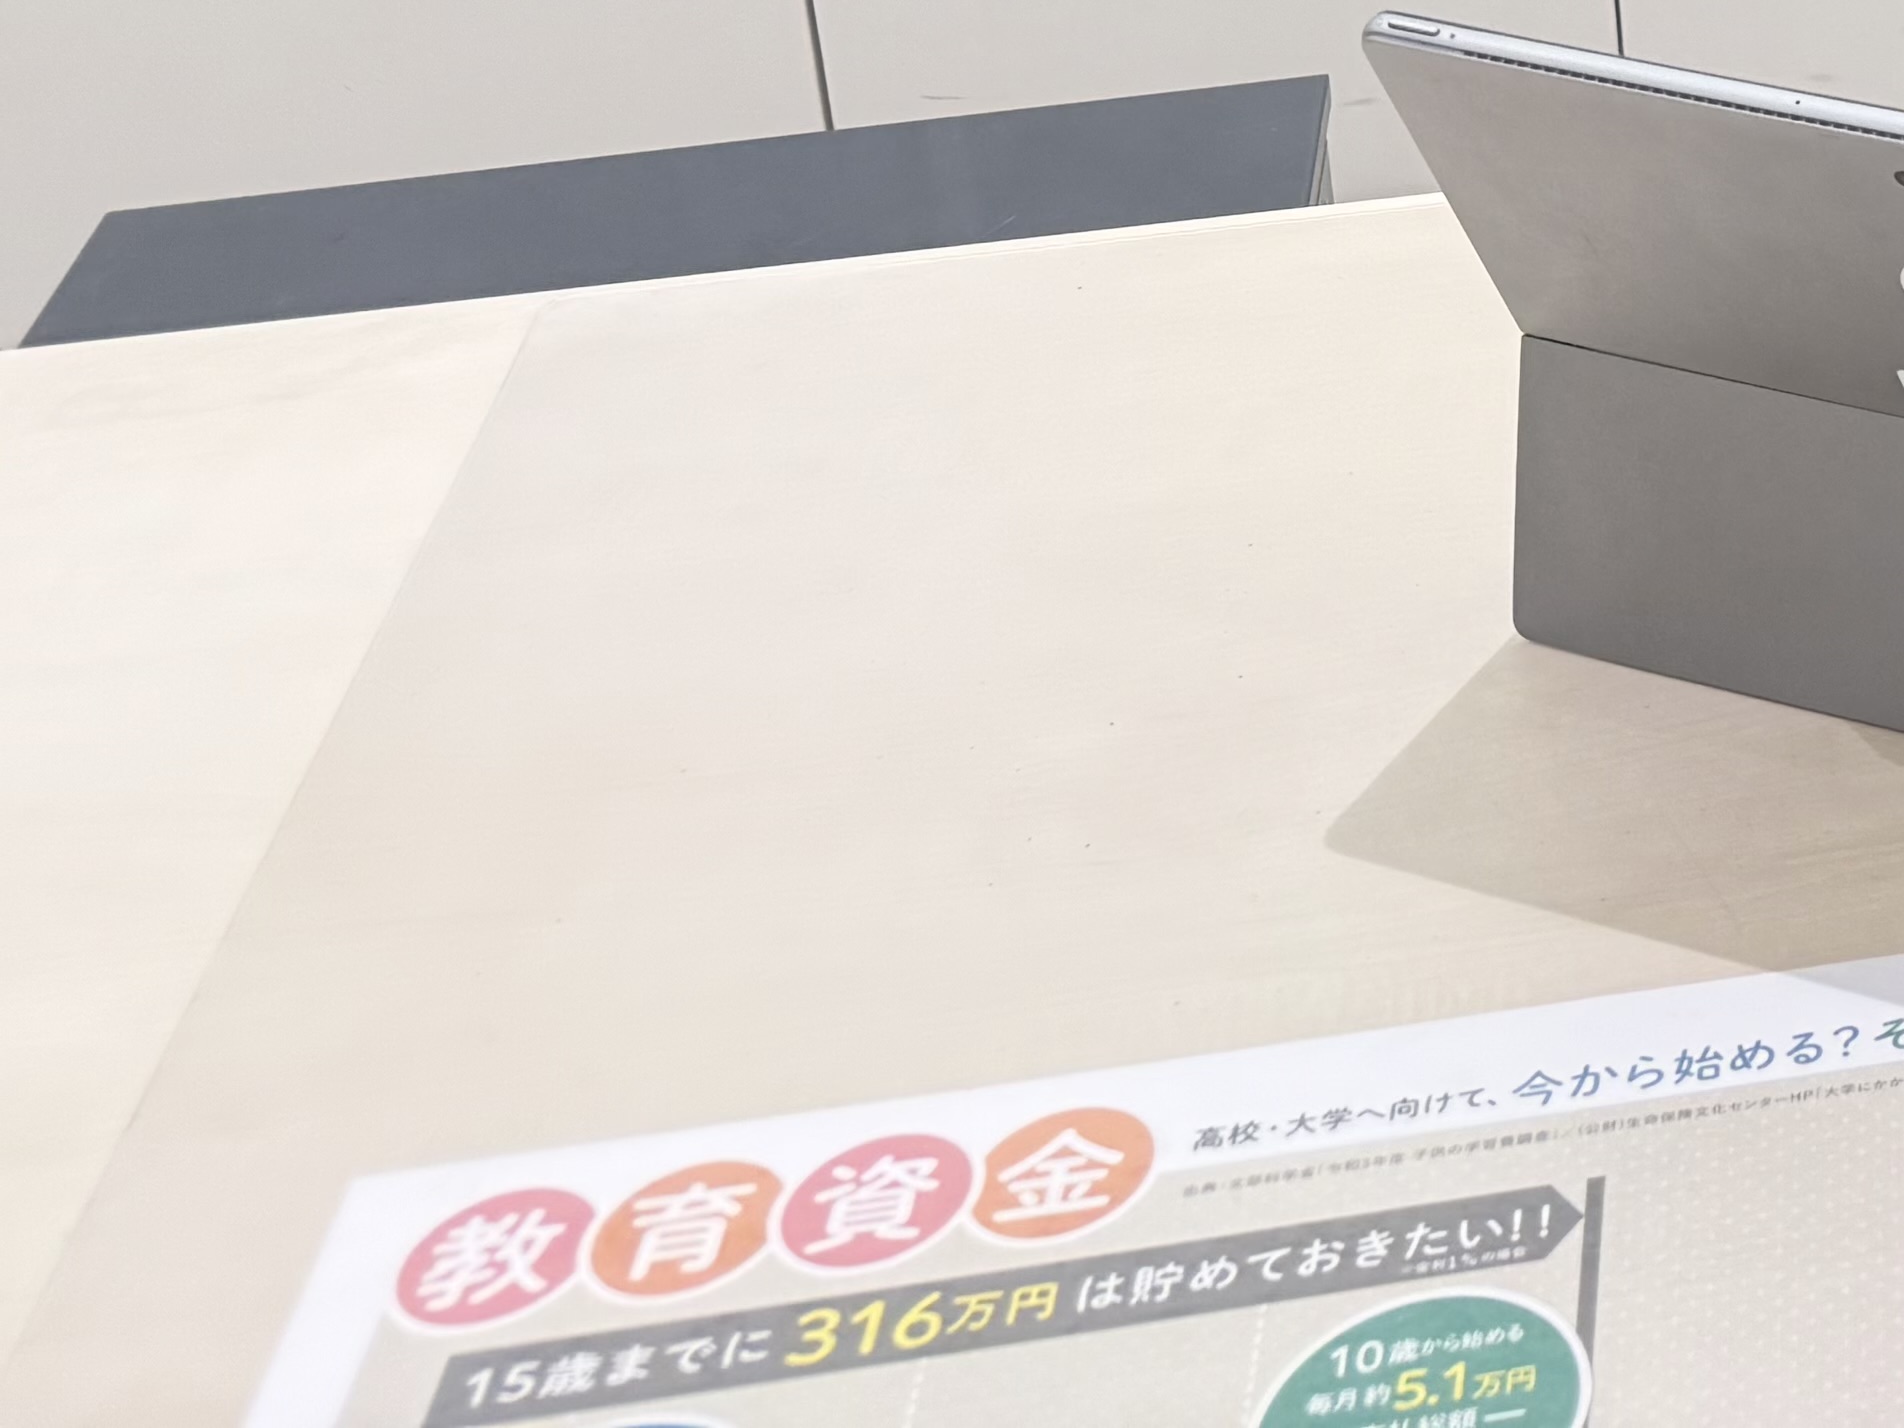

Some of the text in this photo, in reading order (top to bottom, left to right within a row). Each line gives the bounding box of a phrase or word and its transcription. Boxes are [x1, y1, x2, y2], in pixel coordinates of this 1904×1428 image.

[414, 1129, 1125, 1314] 教育資金
[1329, 1322, 1525, 1378] 10歳から始める
